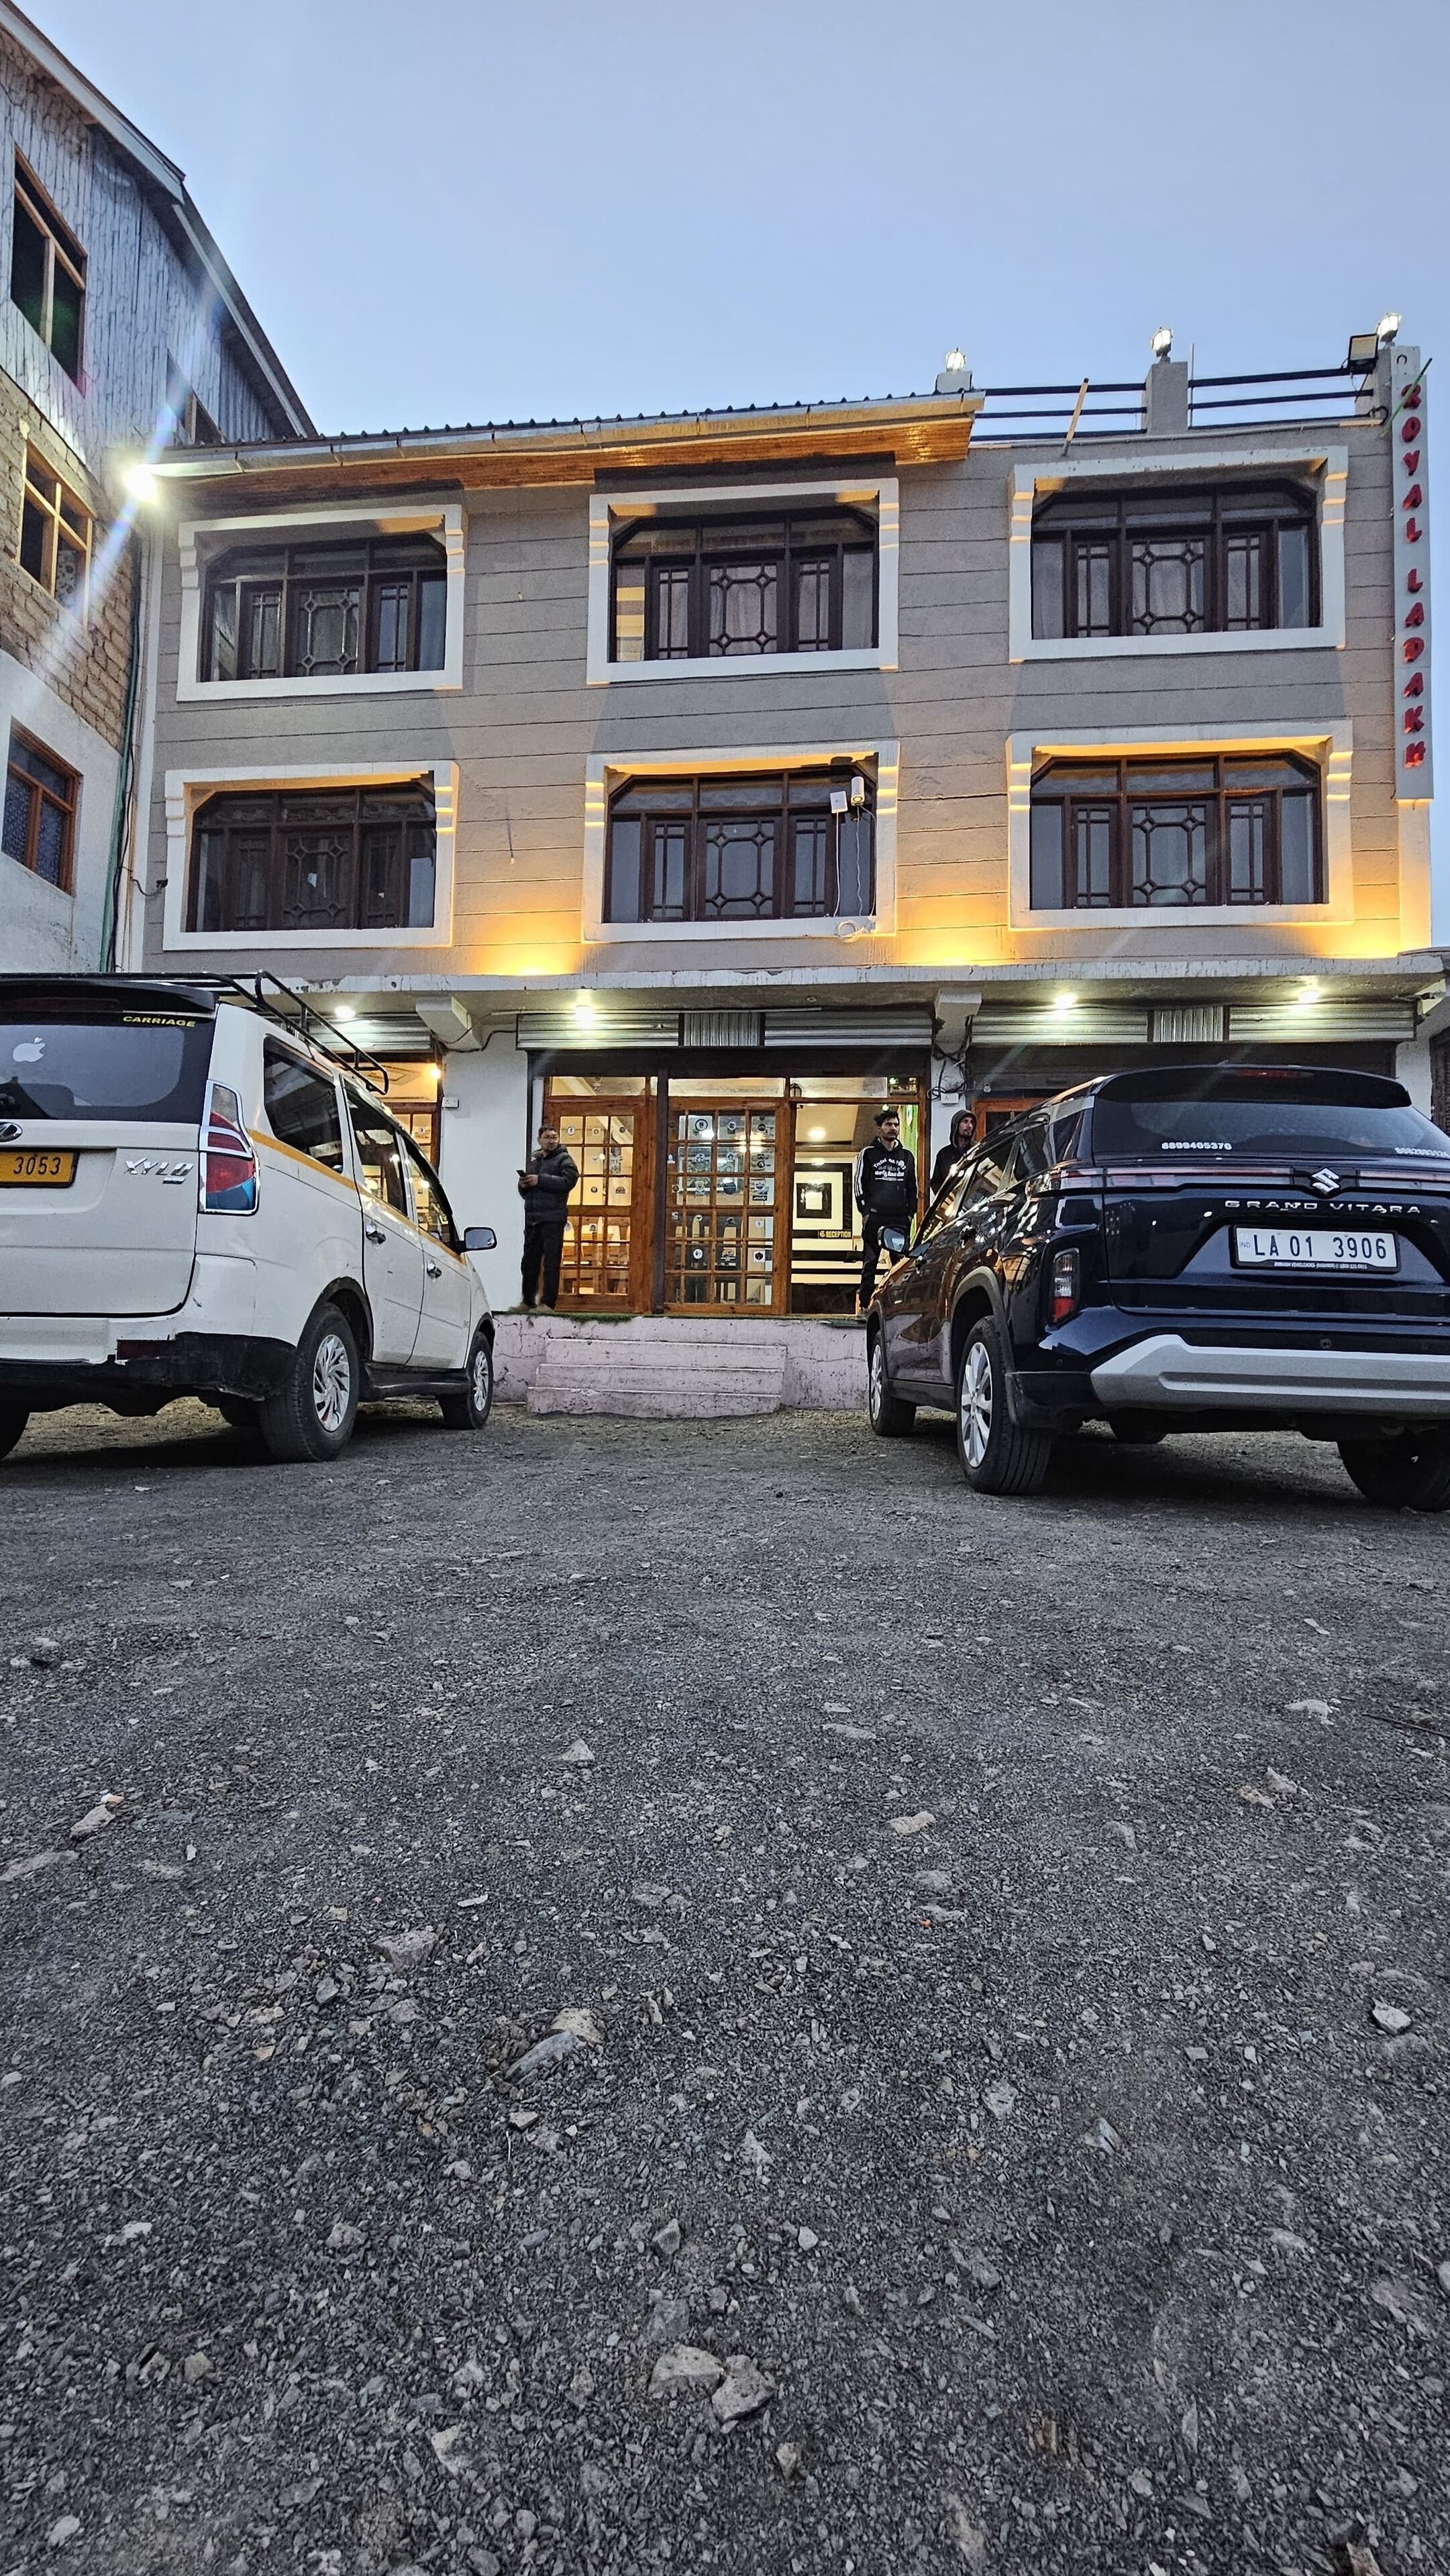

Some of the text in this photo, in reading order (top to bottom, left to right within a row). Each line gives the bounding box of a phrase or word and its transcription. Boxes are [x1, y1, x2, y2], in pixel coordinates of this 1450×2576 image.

[1401, 384, 1426, 769] ROYAL LADAKH
[123, 1016, 196, 1027] CARRIAGE
[13, 1157, 61, 1175] 3053
[123, 1157, 194, 1176] XYLO
[1225, 1200, 1420, 1214] GRAND VITARA
[825, 1230, 851, 1238] RECEPTION
[1253, 1234, 1387, 1259] LA 01 3906
